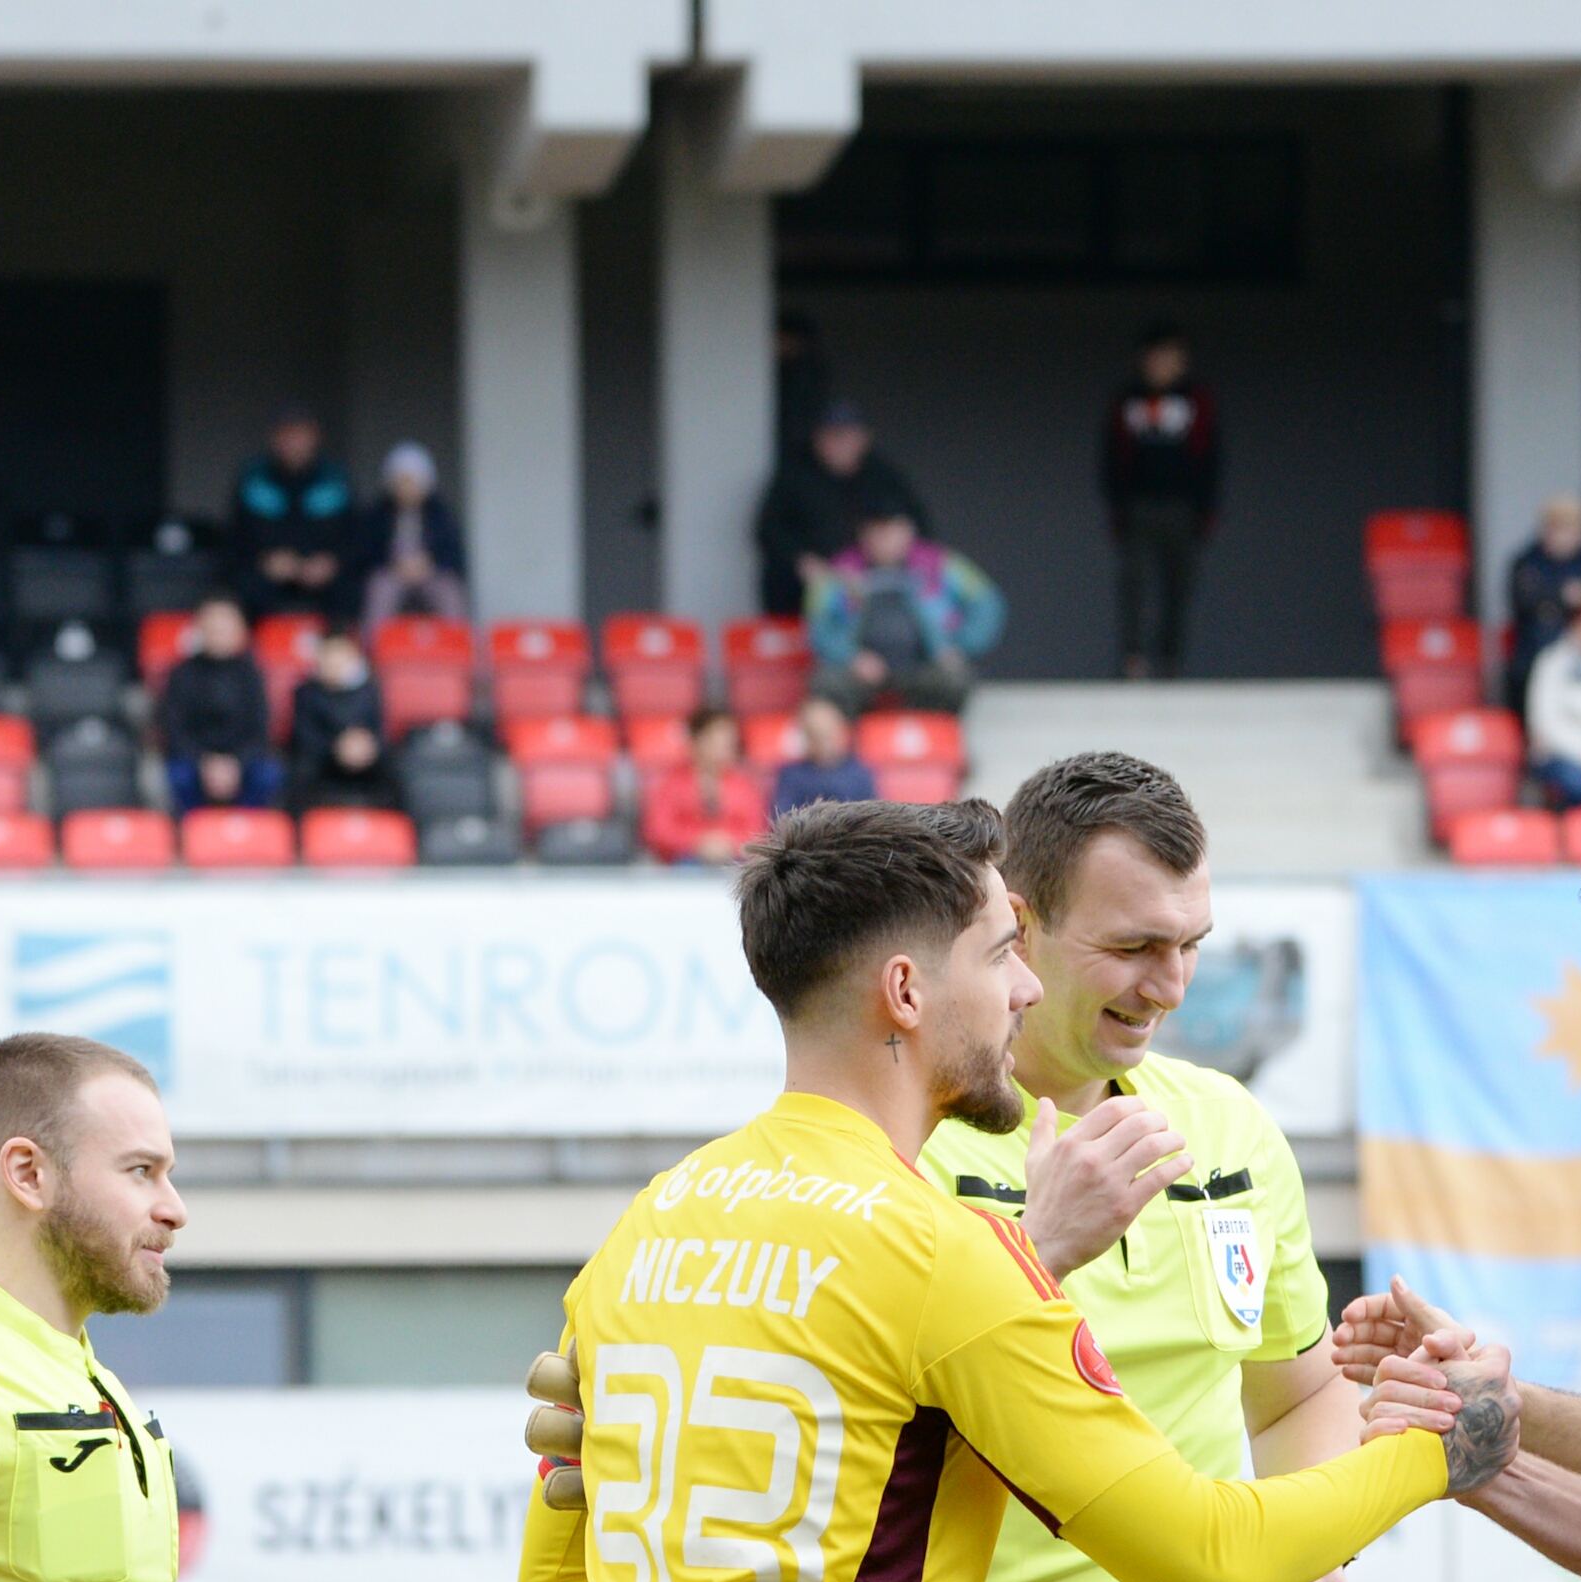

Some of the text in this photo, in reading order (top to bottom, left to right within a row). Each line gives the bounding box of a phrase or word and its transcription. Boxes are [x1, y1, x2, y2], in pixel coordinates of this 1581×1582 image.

[695, 1155, 892, 1221] otpbank
[620, 1238, 841, 1319] NICZULY
[255, 1465, 530, 1554] SZÉKELY
